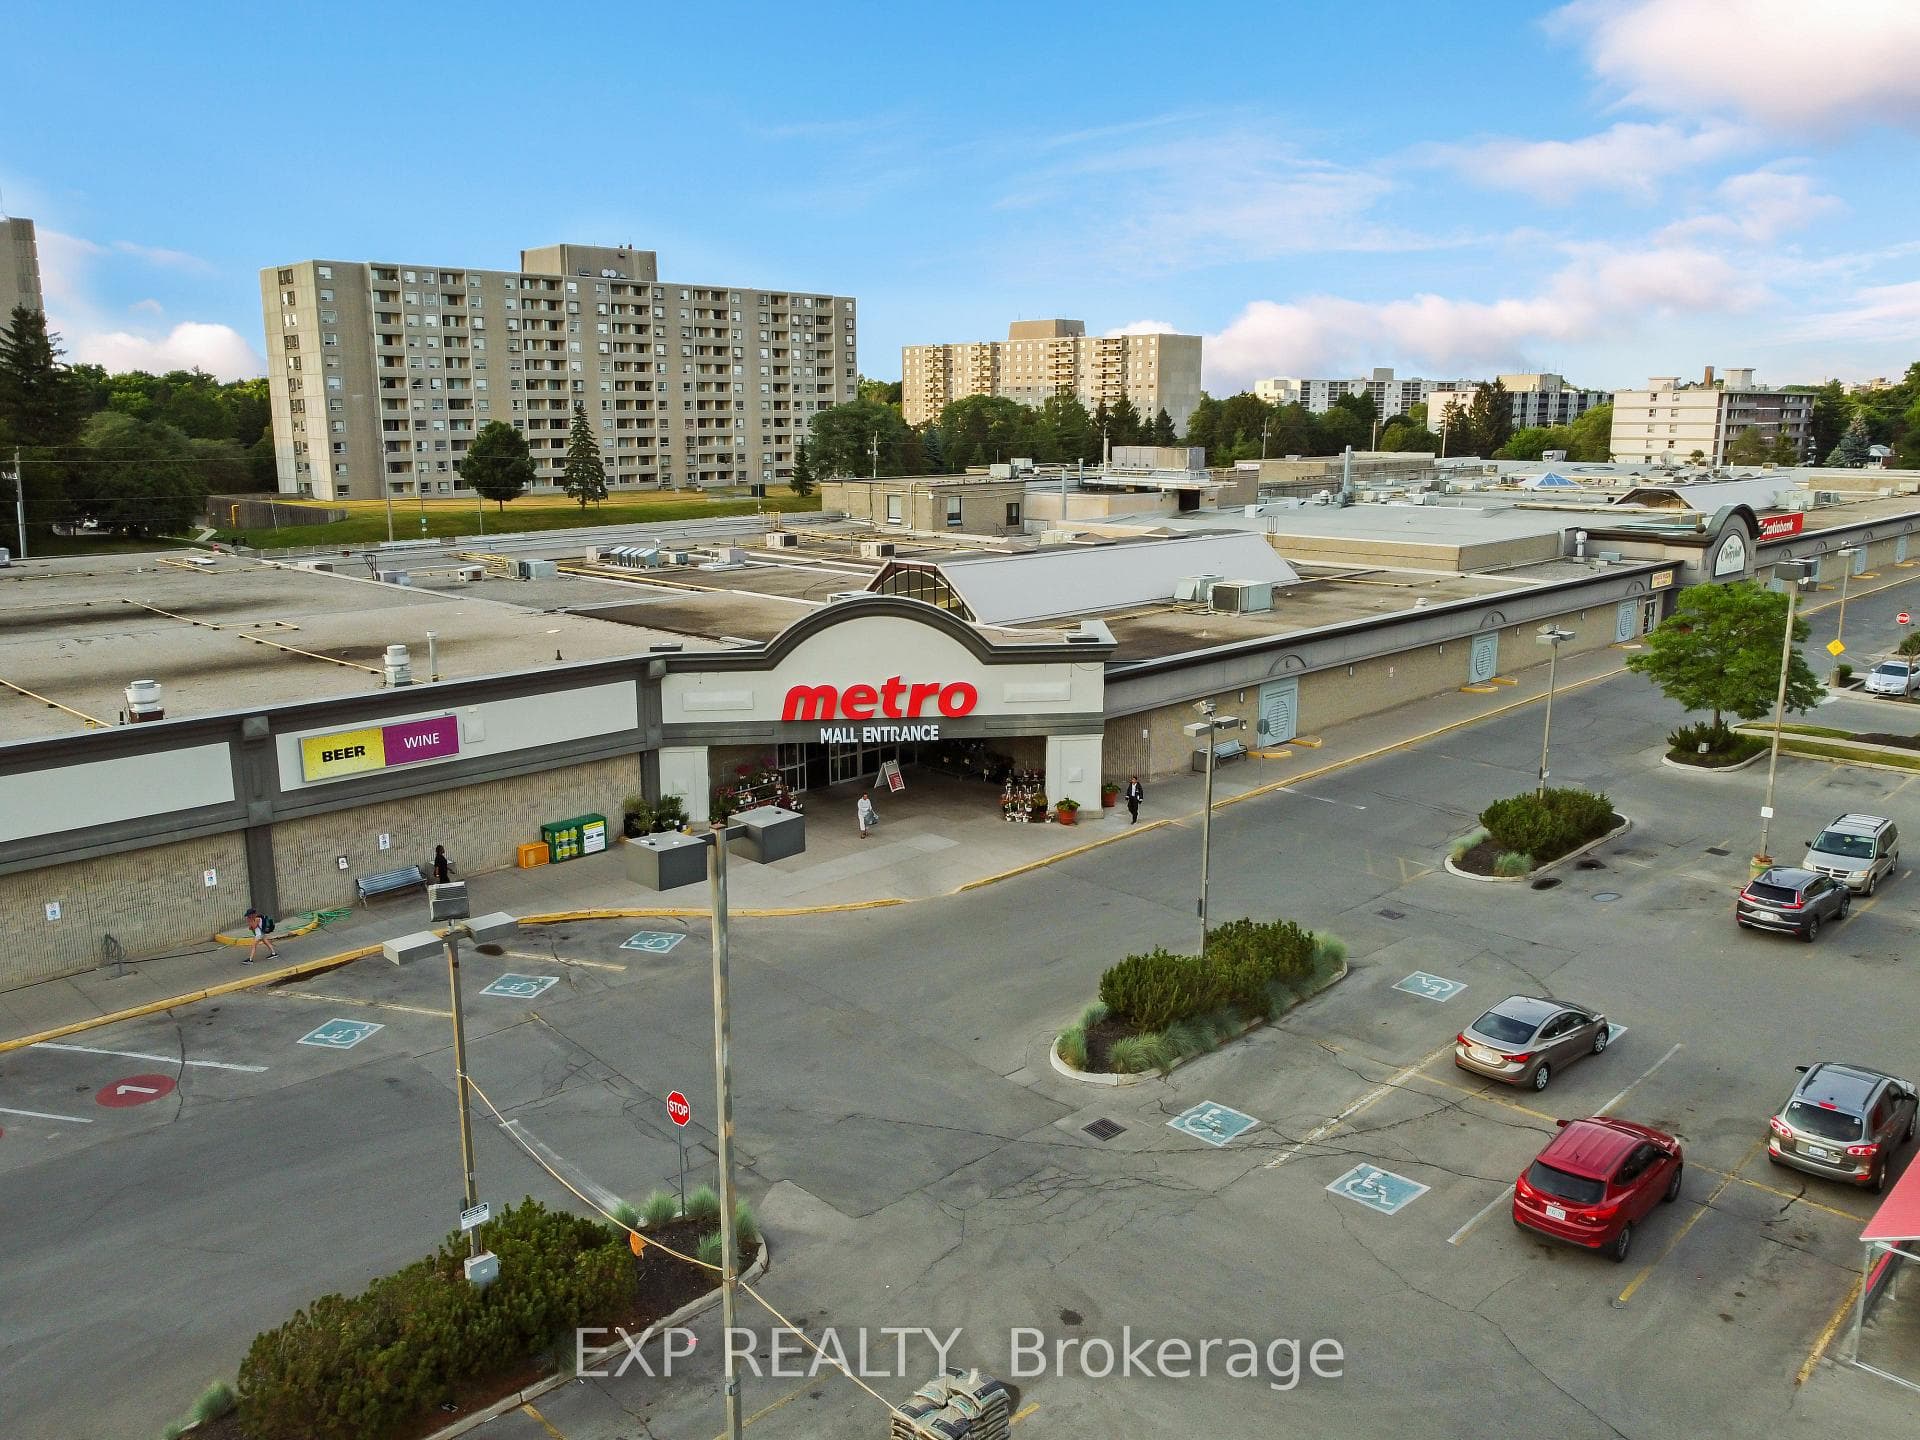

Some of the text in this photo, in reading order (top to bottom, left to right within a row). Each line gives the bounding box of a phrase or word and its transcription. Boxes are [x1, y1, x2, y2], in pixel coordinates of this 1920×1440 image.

[781, 675, 978, 721] metro
[820, 725, 939, 744] MALL ENTRANCE
[322, 733, 440, 763] BEER WINE
[669, 1100, 688, 1117] STOP
